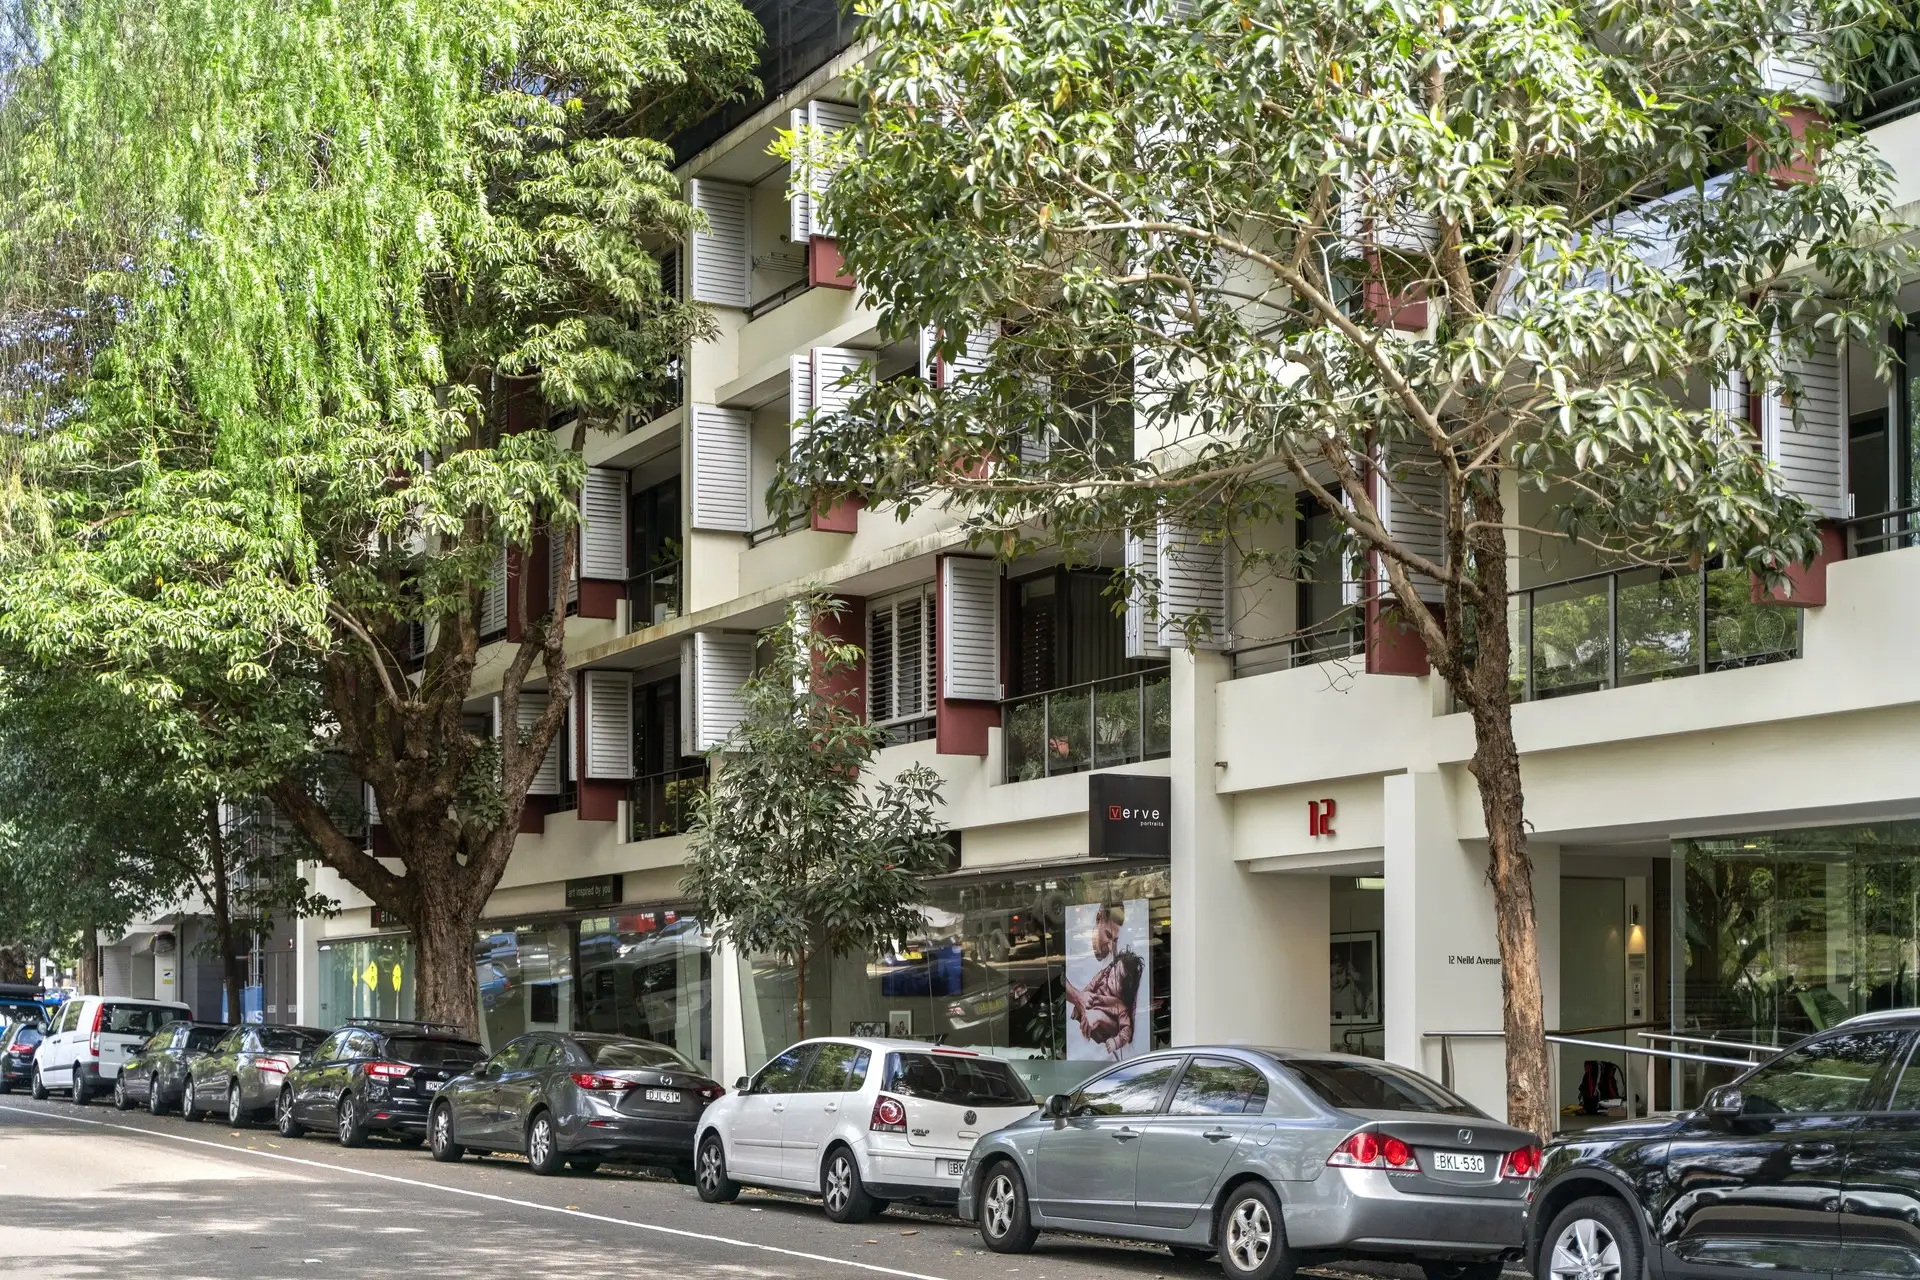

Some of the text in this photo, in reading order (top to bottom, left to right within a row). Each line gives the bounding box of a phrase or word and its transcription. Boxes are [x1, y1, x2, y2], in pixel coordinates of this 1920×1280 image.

[1308, 799, 1337, 836] 12
[576, 886, 594, 899] inspired
[595, 885, 602, 897] by
[602, 885, 611, 897] you
[1448, 955, 1502, 965] 12 Neild Avenue
